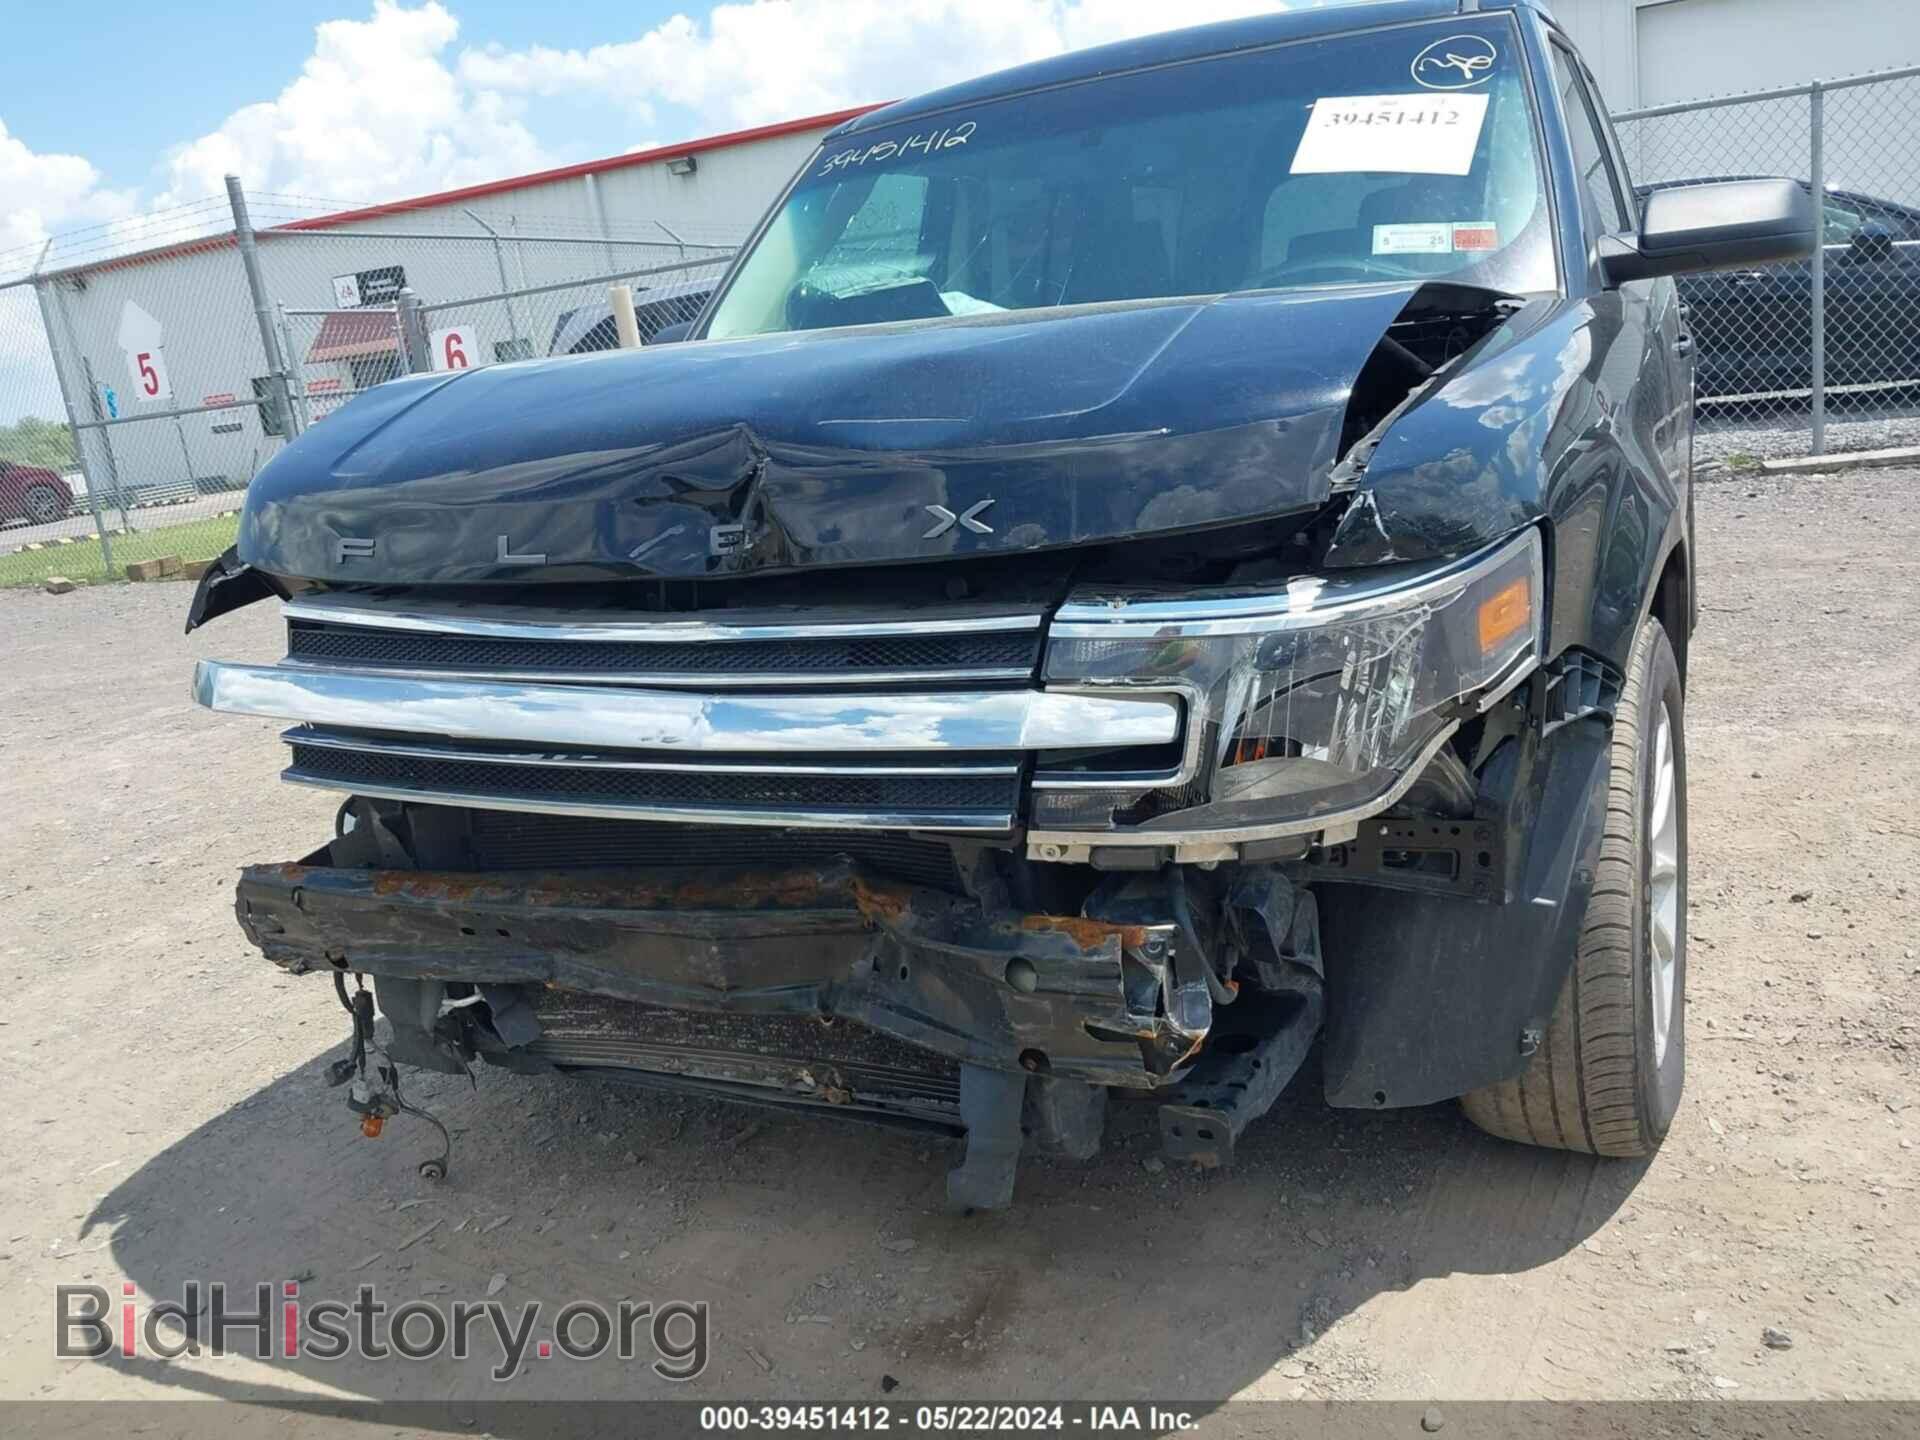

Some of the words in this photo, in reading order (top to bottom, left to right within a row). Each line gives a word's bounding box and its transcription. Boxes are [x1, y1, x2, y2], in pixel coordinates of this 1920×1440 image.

[1323, 110, 1460, 128] 39451412
[817, 121, 977, 177] 39451412
[137, 352, 160, 396] 5
